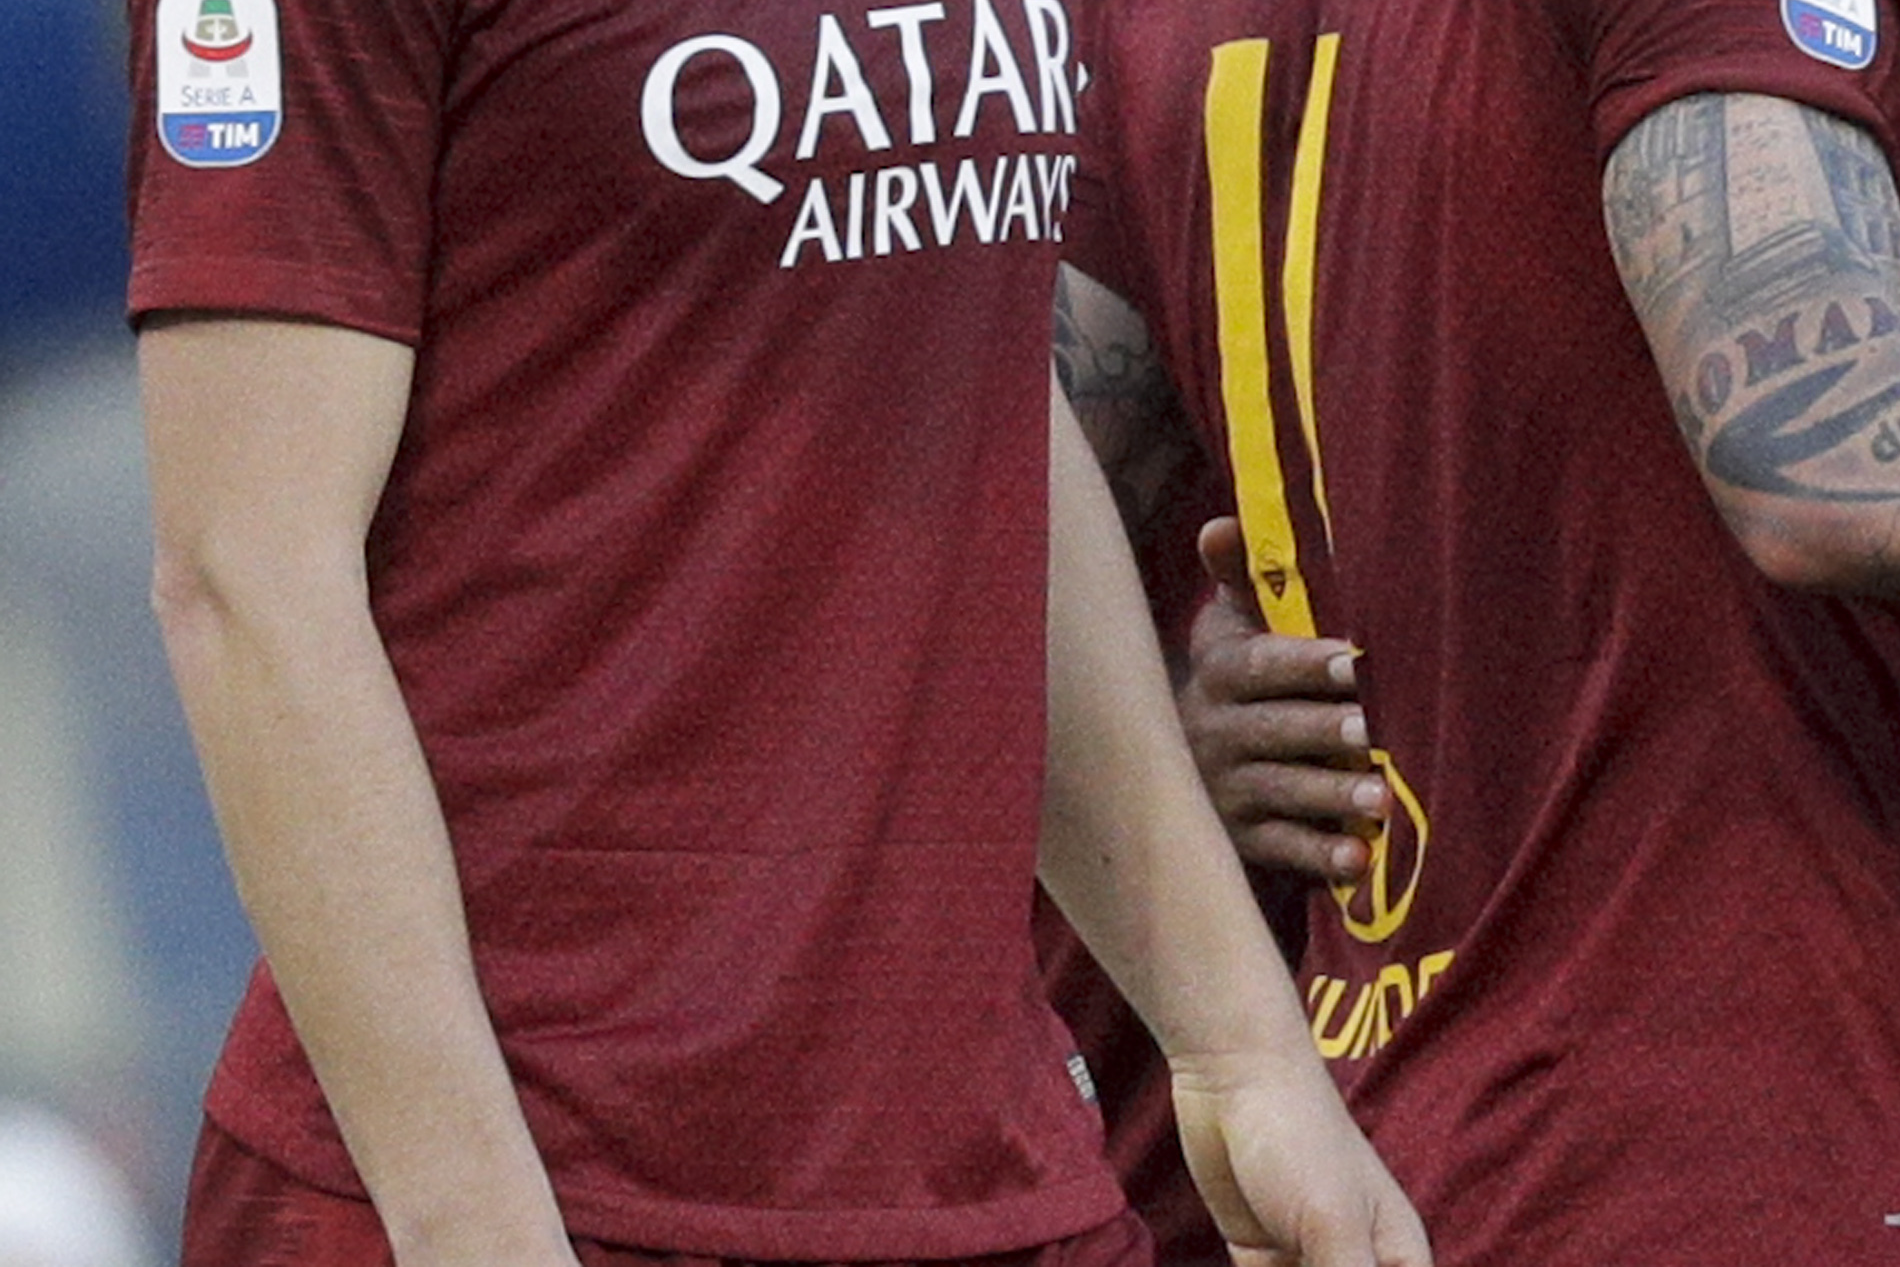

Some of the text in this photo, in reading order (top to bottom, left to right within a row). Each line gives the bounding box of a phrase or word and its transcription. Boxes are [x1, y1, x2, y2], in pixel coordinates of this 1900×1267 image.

[1822, 20, 1863, 58] TIM
[181, 85, 257, 108] SERIE A
[207, 122, 262, 150] TIM
[1205, 32, 1342, 640] 11
